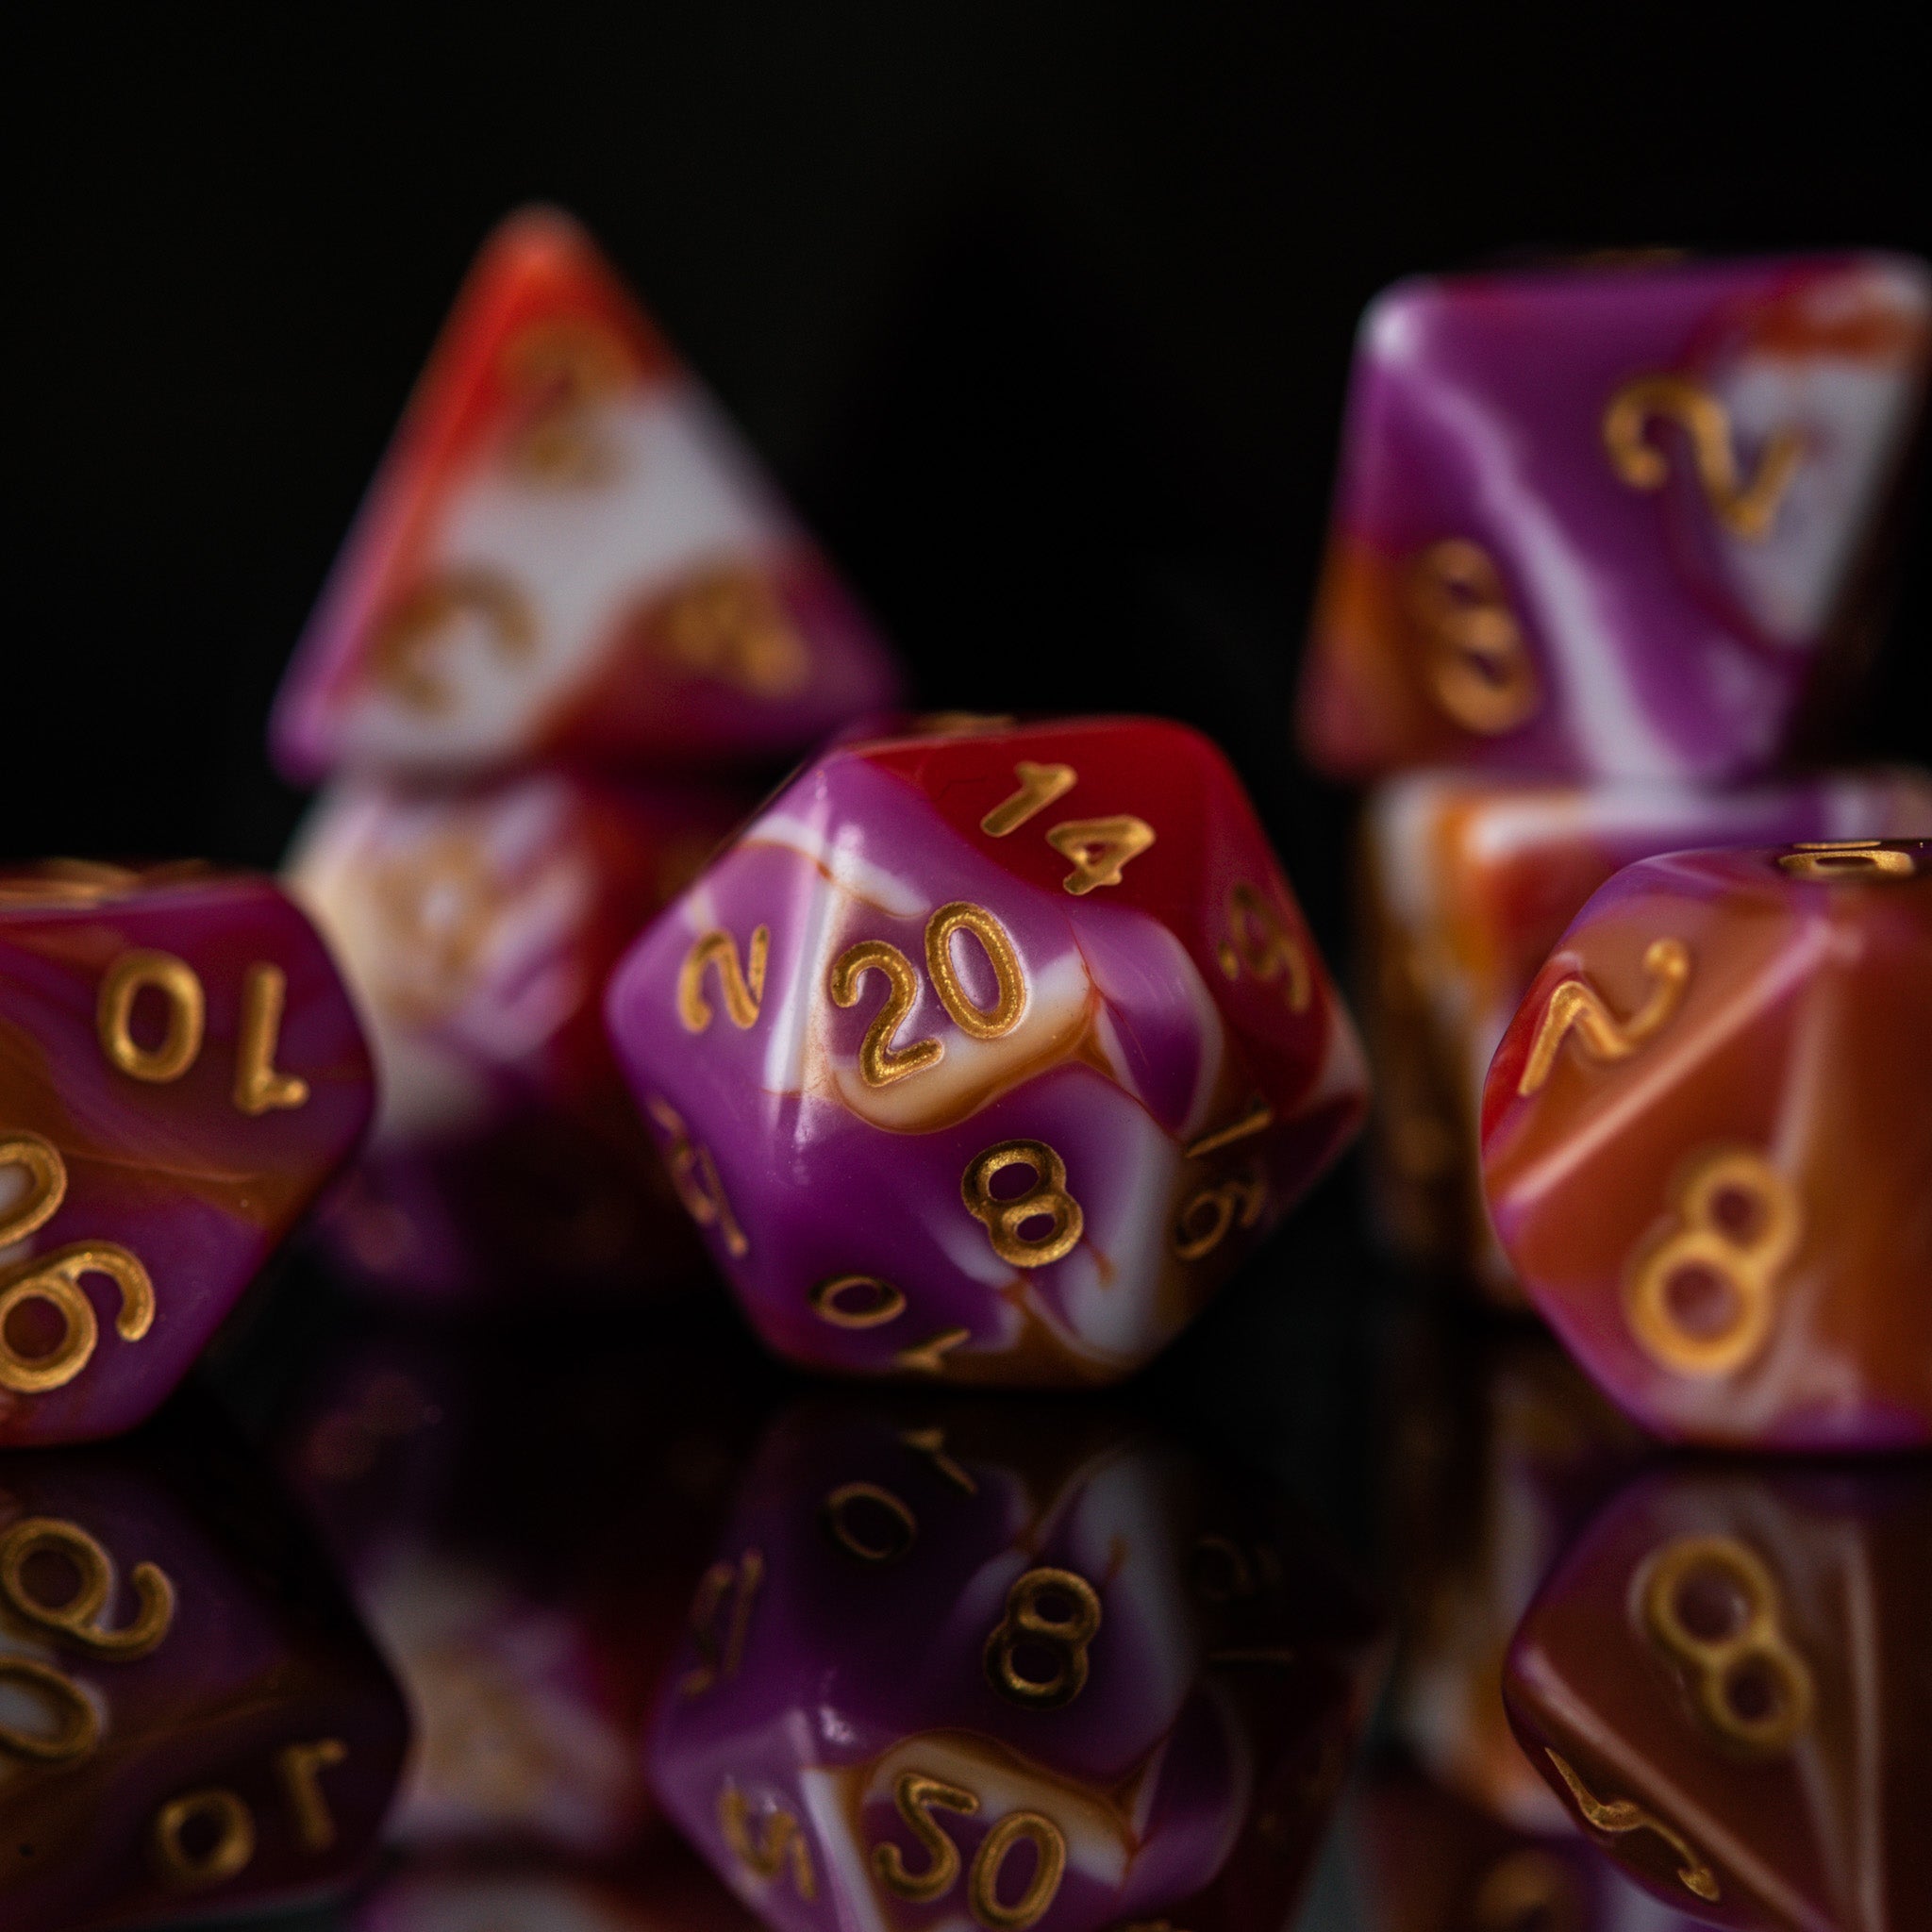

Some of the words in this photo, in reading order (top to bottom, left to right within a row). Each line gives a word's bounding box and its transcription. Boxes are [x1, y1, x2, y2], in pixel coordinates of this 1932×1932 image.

[979, 760, 1157, 895] 14
[98, 947, 310, 1115] 10
[678, 924, 770, 1032] 2
[831, 901, 1028, 1087] 20
[1517, 939, 1689, 1097] 2
[960, 1139, 1084, 1268] 8
[1624, 1143, 1799, 1378] 8
